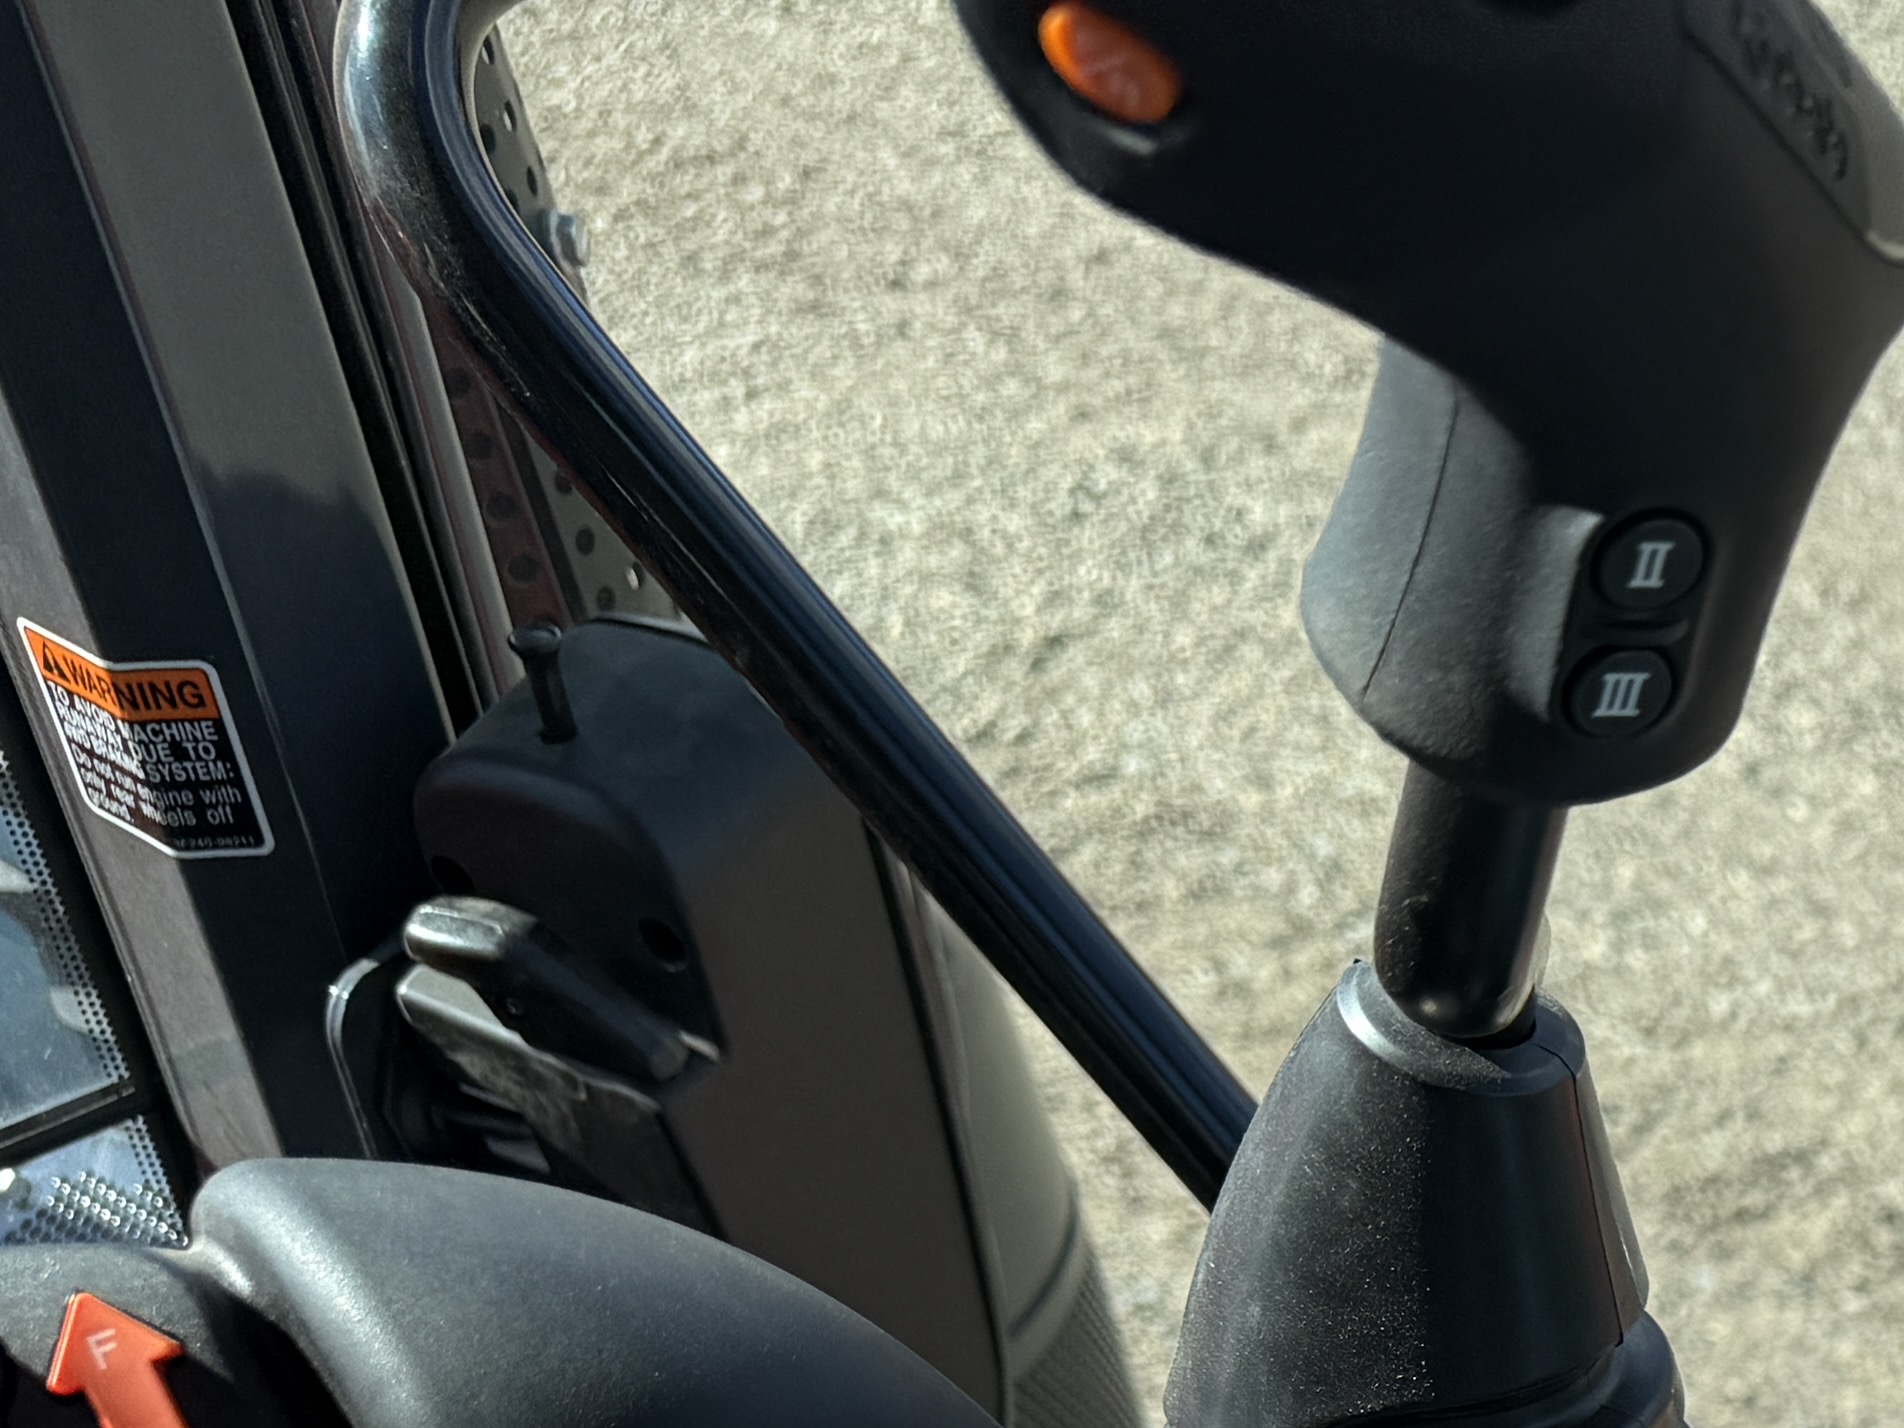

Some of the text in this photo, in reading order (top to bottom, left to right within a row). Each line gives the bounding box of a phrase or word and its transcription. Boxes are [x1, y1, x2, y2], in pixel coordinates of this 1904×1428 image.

[64, 655, 206, 711] WARNING
[117, 717, 218, 744] MACHINE
[131, 741, 175, 763] DUE
[183, 741, 217, 762] TO
[149, 762, 235, 784] SYSTEM:
[200, 783, 243, 805] with
[207, 803, 234, 826] off
[87, 1328, 117, 1370] F
